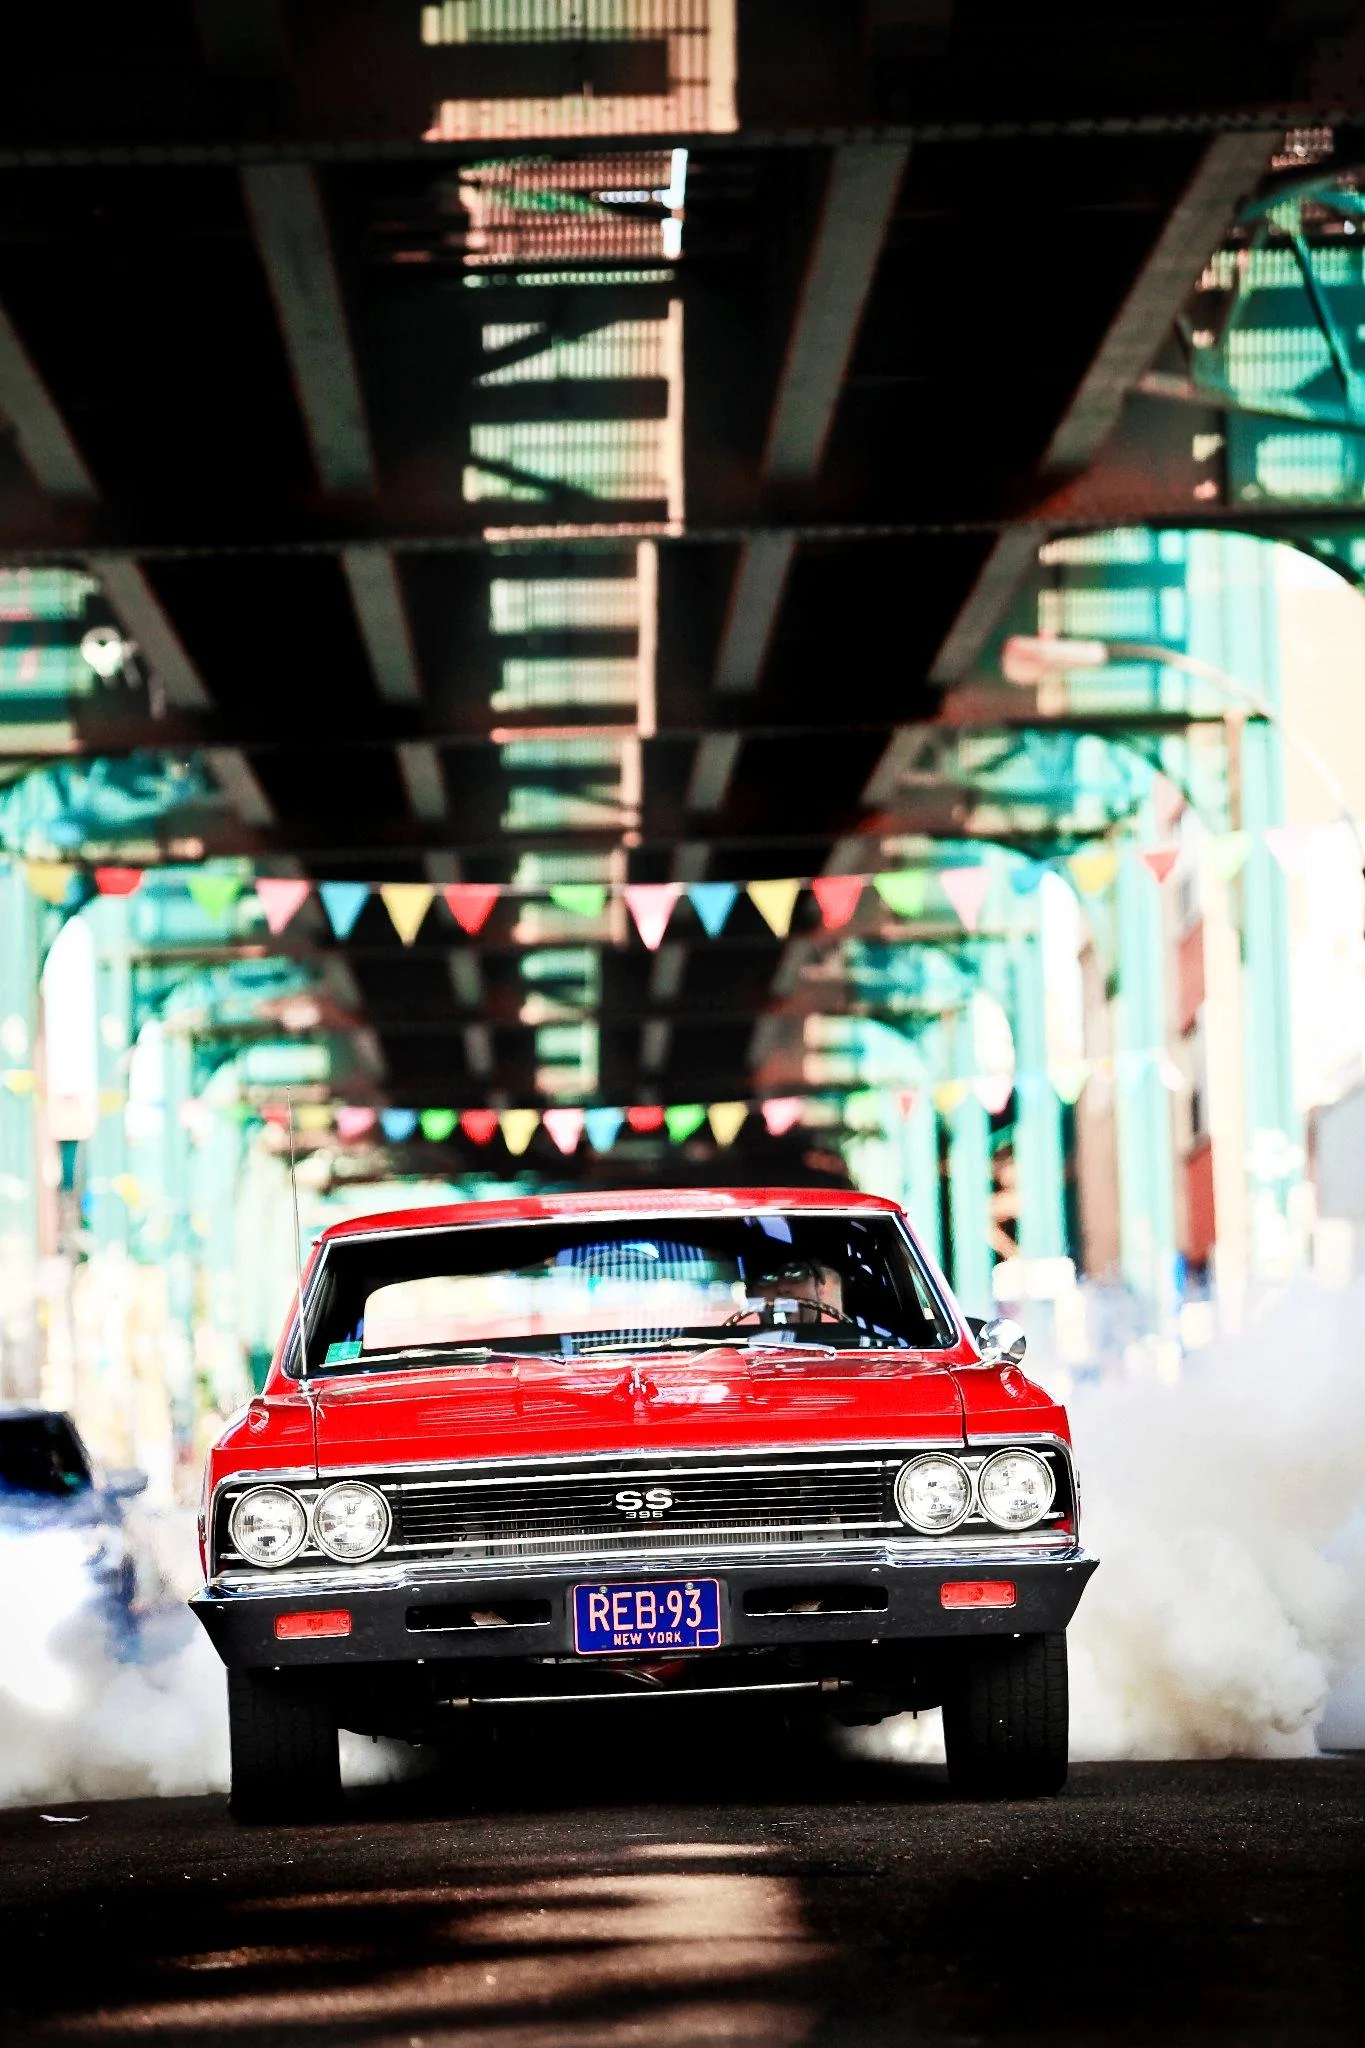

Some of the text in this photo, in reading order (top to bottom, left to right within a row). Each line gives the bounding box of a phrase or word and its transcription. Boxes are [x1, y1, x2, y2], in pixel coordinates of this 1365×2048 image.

[615, 1488, 673, 1511] SS
[625, 1510, 664, 1519] 396
[613, 1631, 682, 1646] NEW YORK
